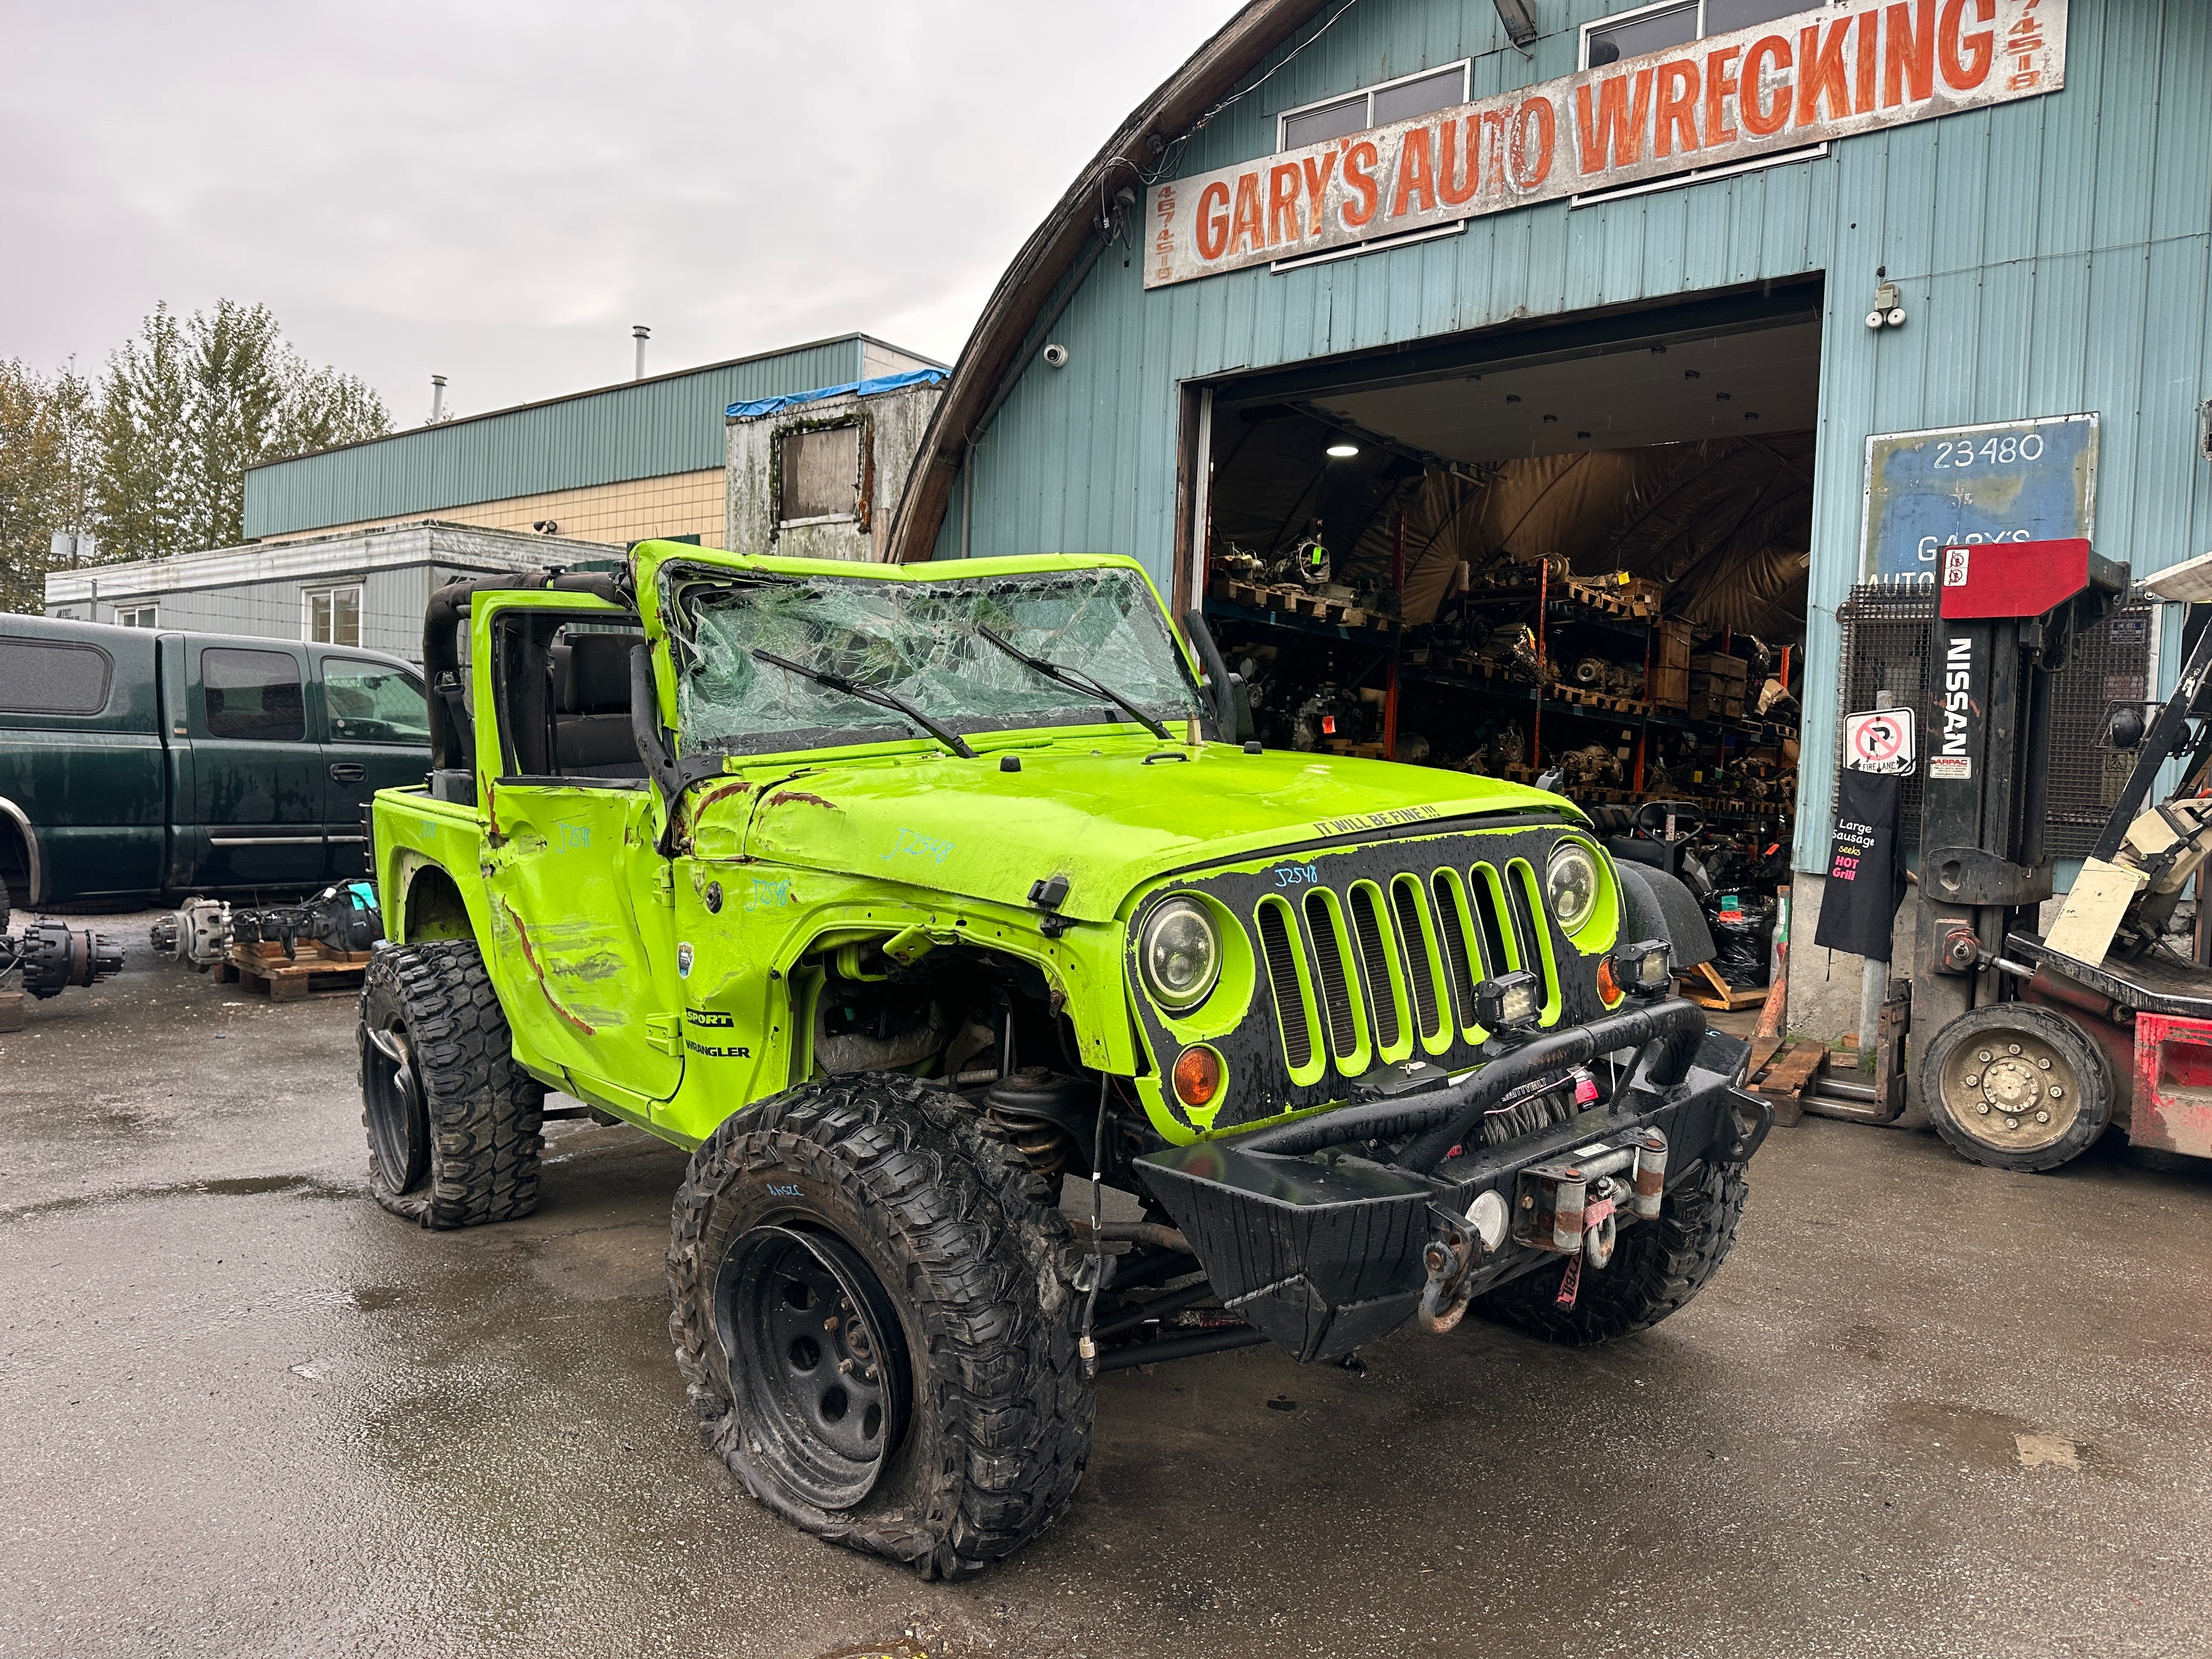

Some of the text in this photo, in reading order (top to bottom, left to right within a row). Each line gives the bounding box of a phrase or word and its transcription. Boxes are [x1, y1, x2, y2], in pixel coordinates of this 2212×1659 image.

[1196, 0, 1995, 260] GARY'S AUTO WRECKING
[1933, 434, 2044, 468] 23480
[1942, 638, 1971, 755] NISSAN
[1313, 823, 1332, 835] IT
[1329, 817, 1371, 832] WILL
[1368, 813, 1392, 827] BE
[1391, 808, 1425, 824] FINE
[1839, 819, 1872, 835] Large
[556, 822, 590, 854] J2548
[881, 828, 956, 863] J2548
[1832, 829, 1874, 848] Sausage
[1839, 845, 1861, 856] seeks
[1835, 855, 1859, 869] HOT
[1275, 865, 1318, 887] J2548
[1832, 867, 1856, 881] Grill
[745, 878, 789, 912] J2548
[687, 1011, 733, 1024] SPORT
[685, 1039, 751, 1058] WRANGLER
